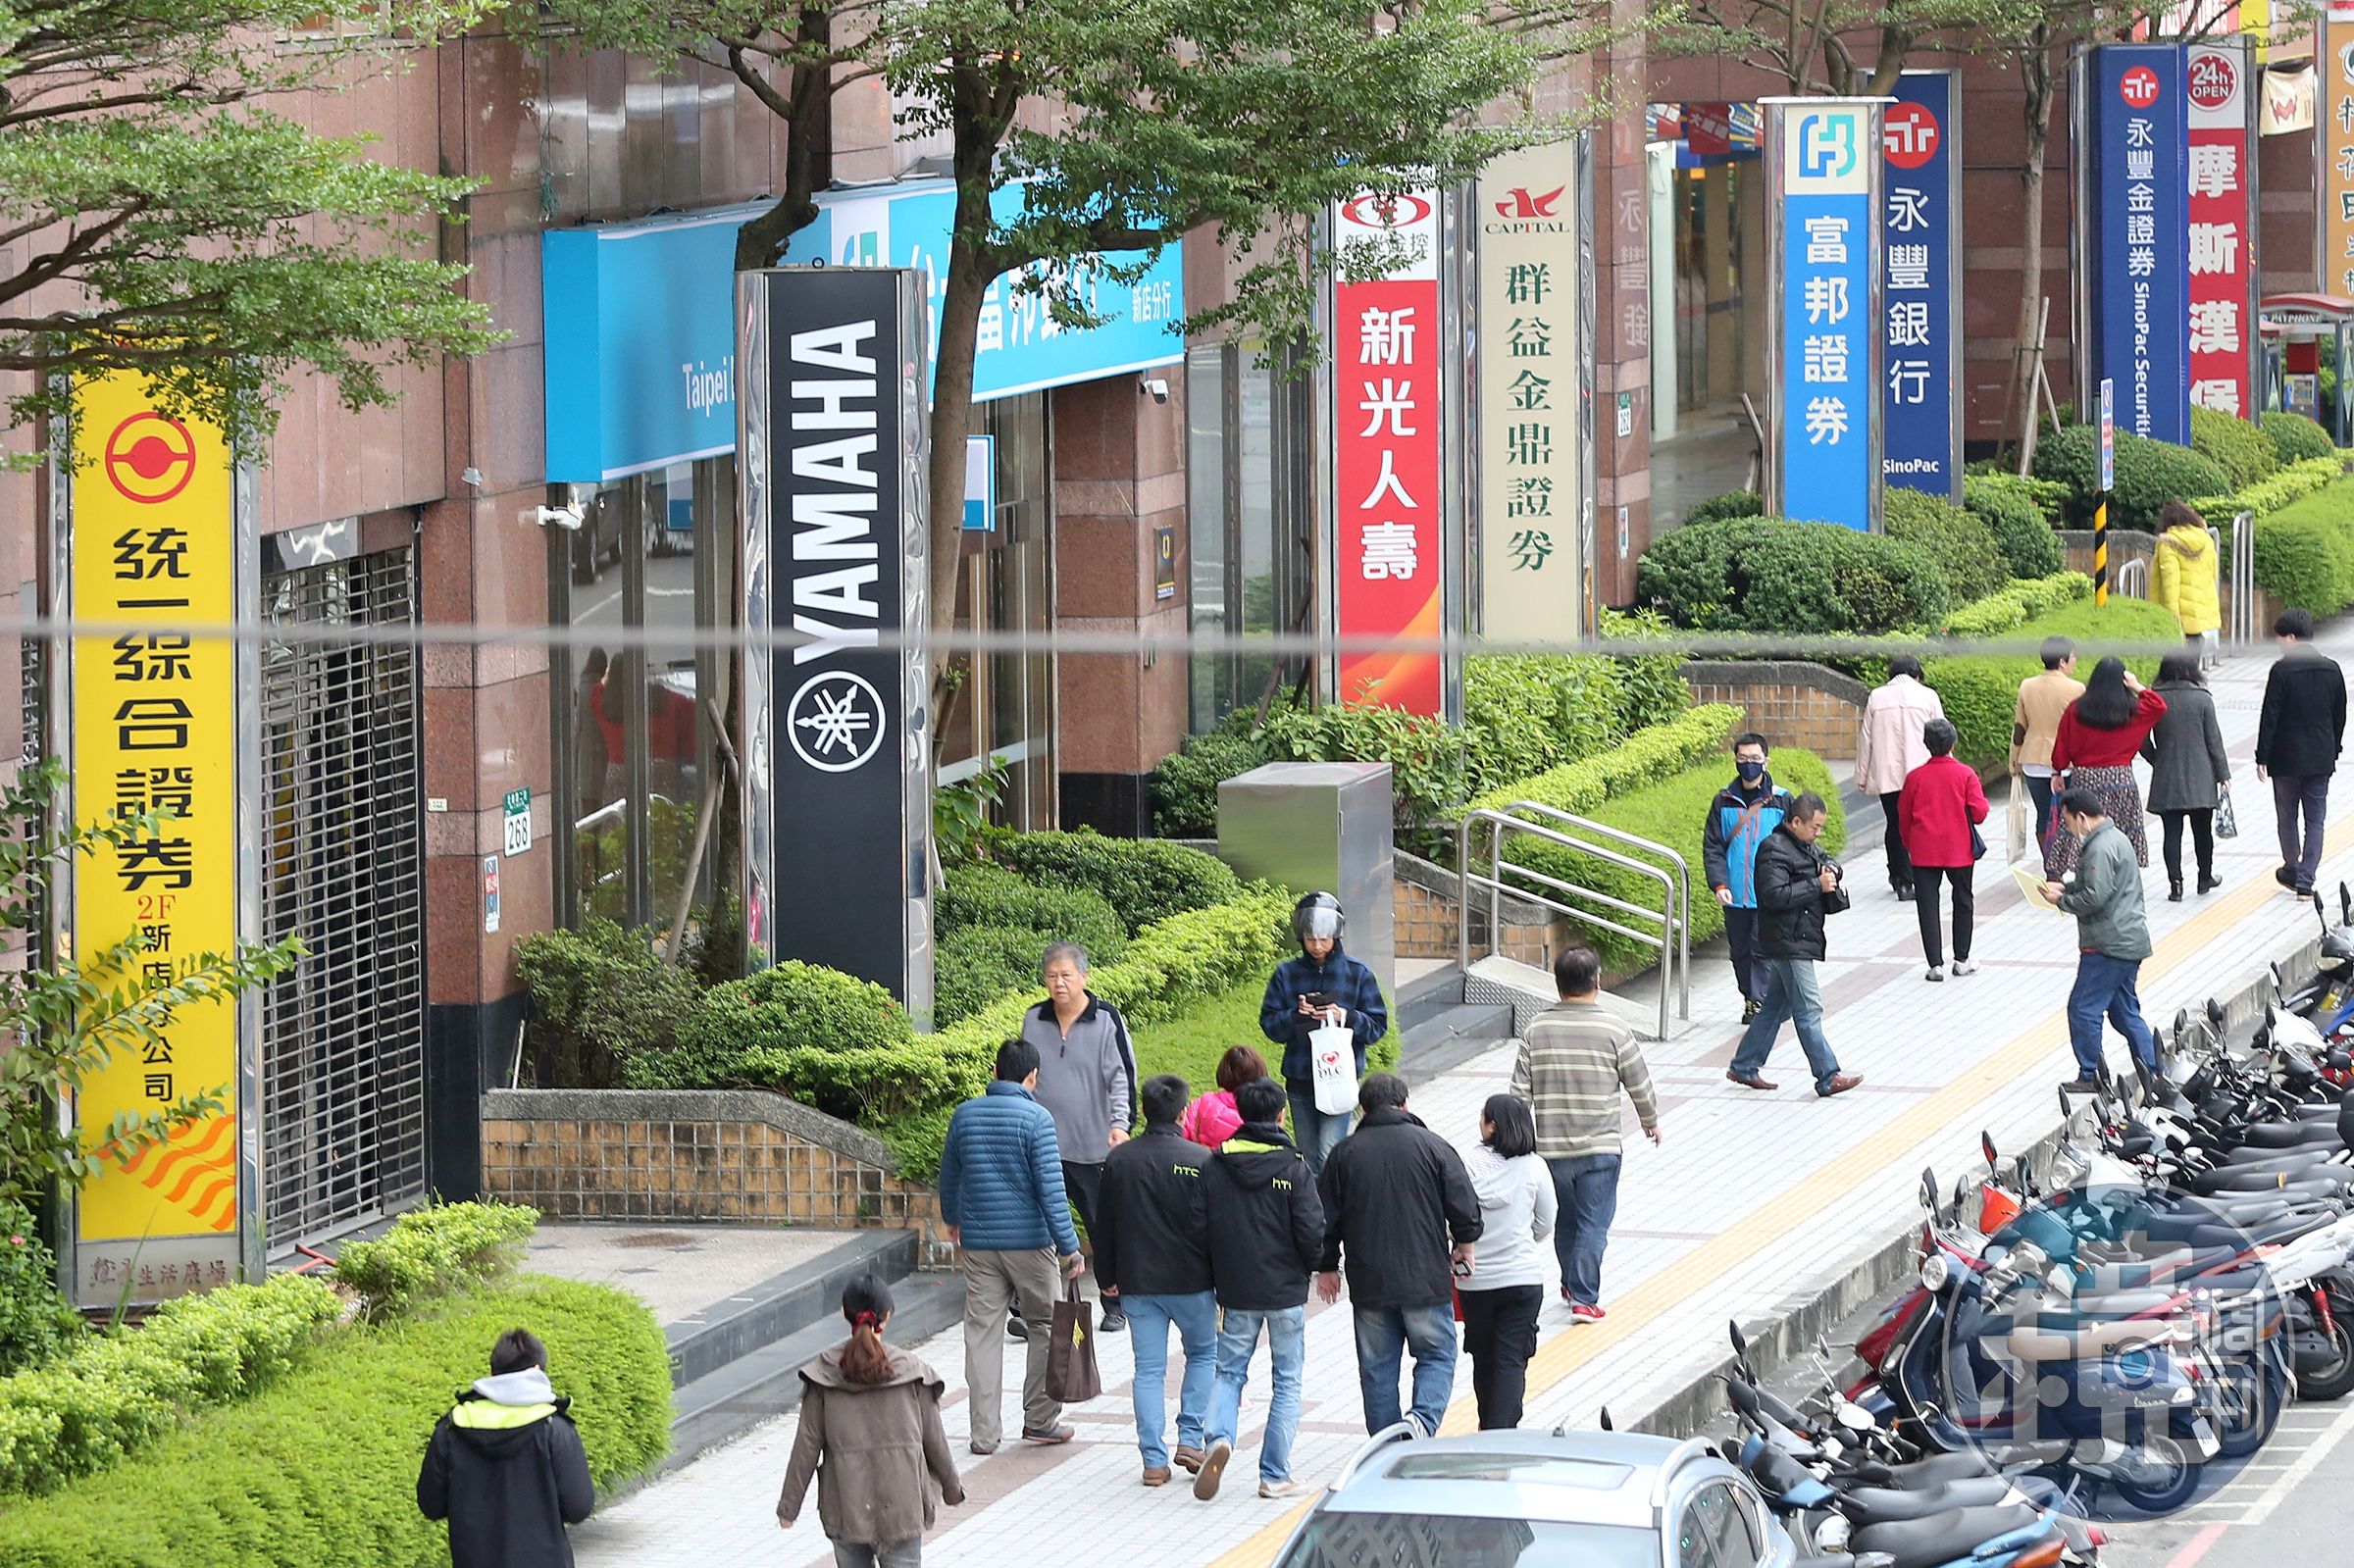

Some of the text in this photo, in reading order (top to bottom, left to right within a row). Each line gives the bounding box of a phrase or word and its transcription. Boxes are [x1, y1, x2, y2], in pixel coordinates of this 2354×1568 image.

[2191, 62, 2228, 85] 24h
[2191, 85, 2229, 98] OPEN
[1485, 221, 1570, 234] CAPITAL
[2126, 118, 2156, 277] 永豐金證券
[1131, 280, 1171, 323] 新店分行
[1886, 186, 1931, 405] 永豐銀行
[2134, 281, 2150, 355] SinoPac
[1804, 215, 1850, 446] 富邦證券
[682, 355, 728, 418] Taipei
[1505, 262, 1555, 572] 群益金鼎證券
[1358, 306, 1419, 581] 新光人壽
[1883, 458, 1940, 474] SinoPac
[790, 319, 880, 667] YAMAHA
[112, 528, 194, 892] 統一綜合證券
[508, 817, 528, 850] 268
[136, 894, 177, 920] 2F
